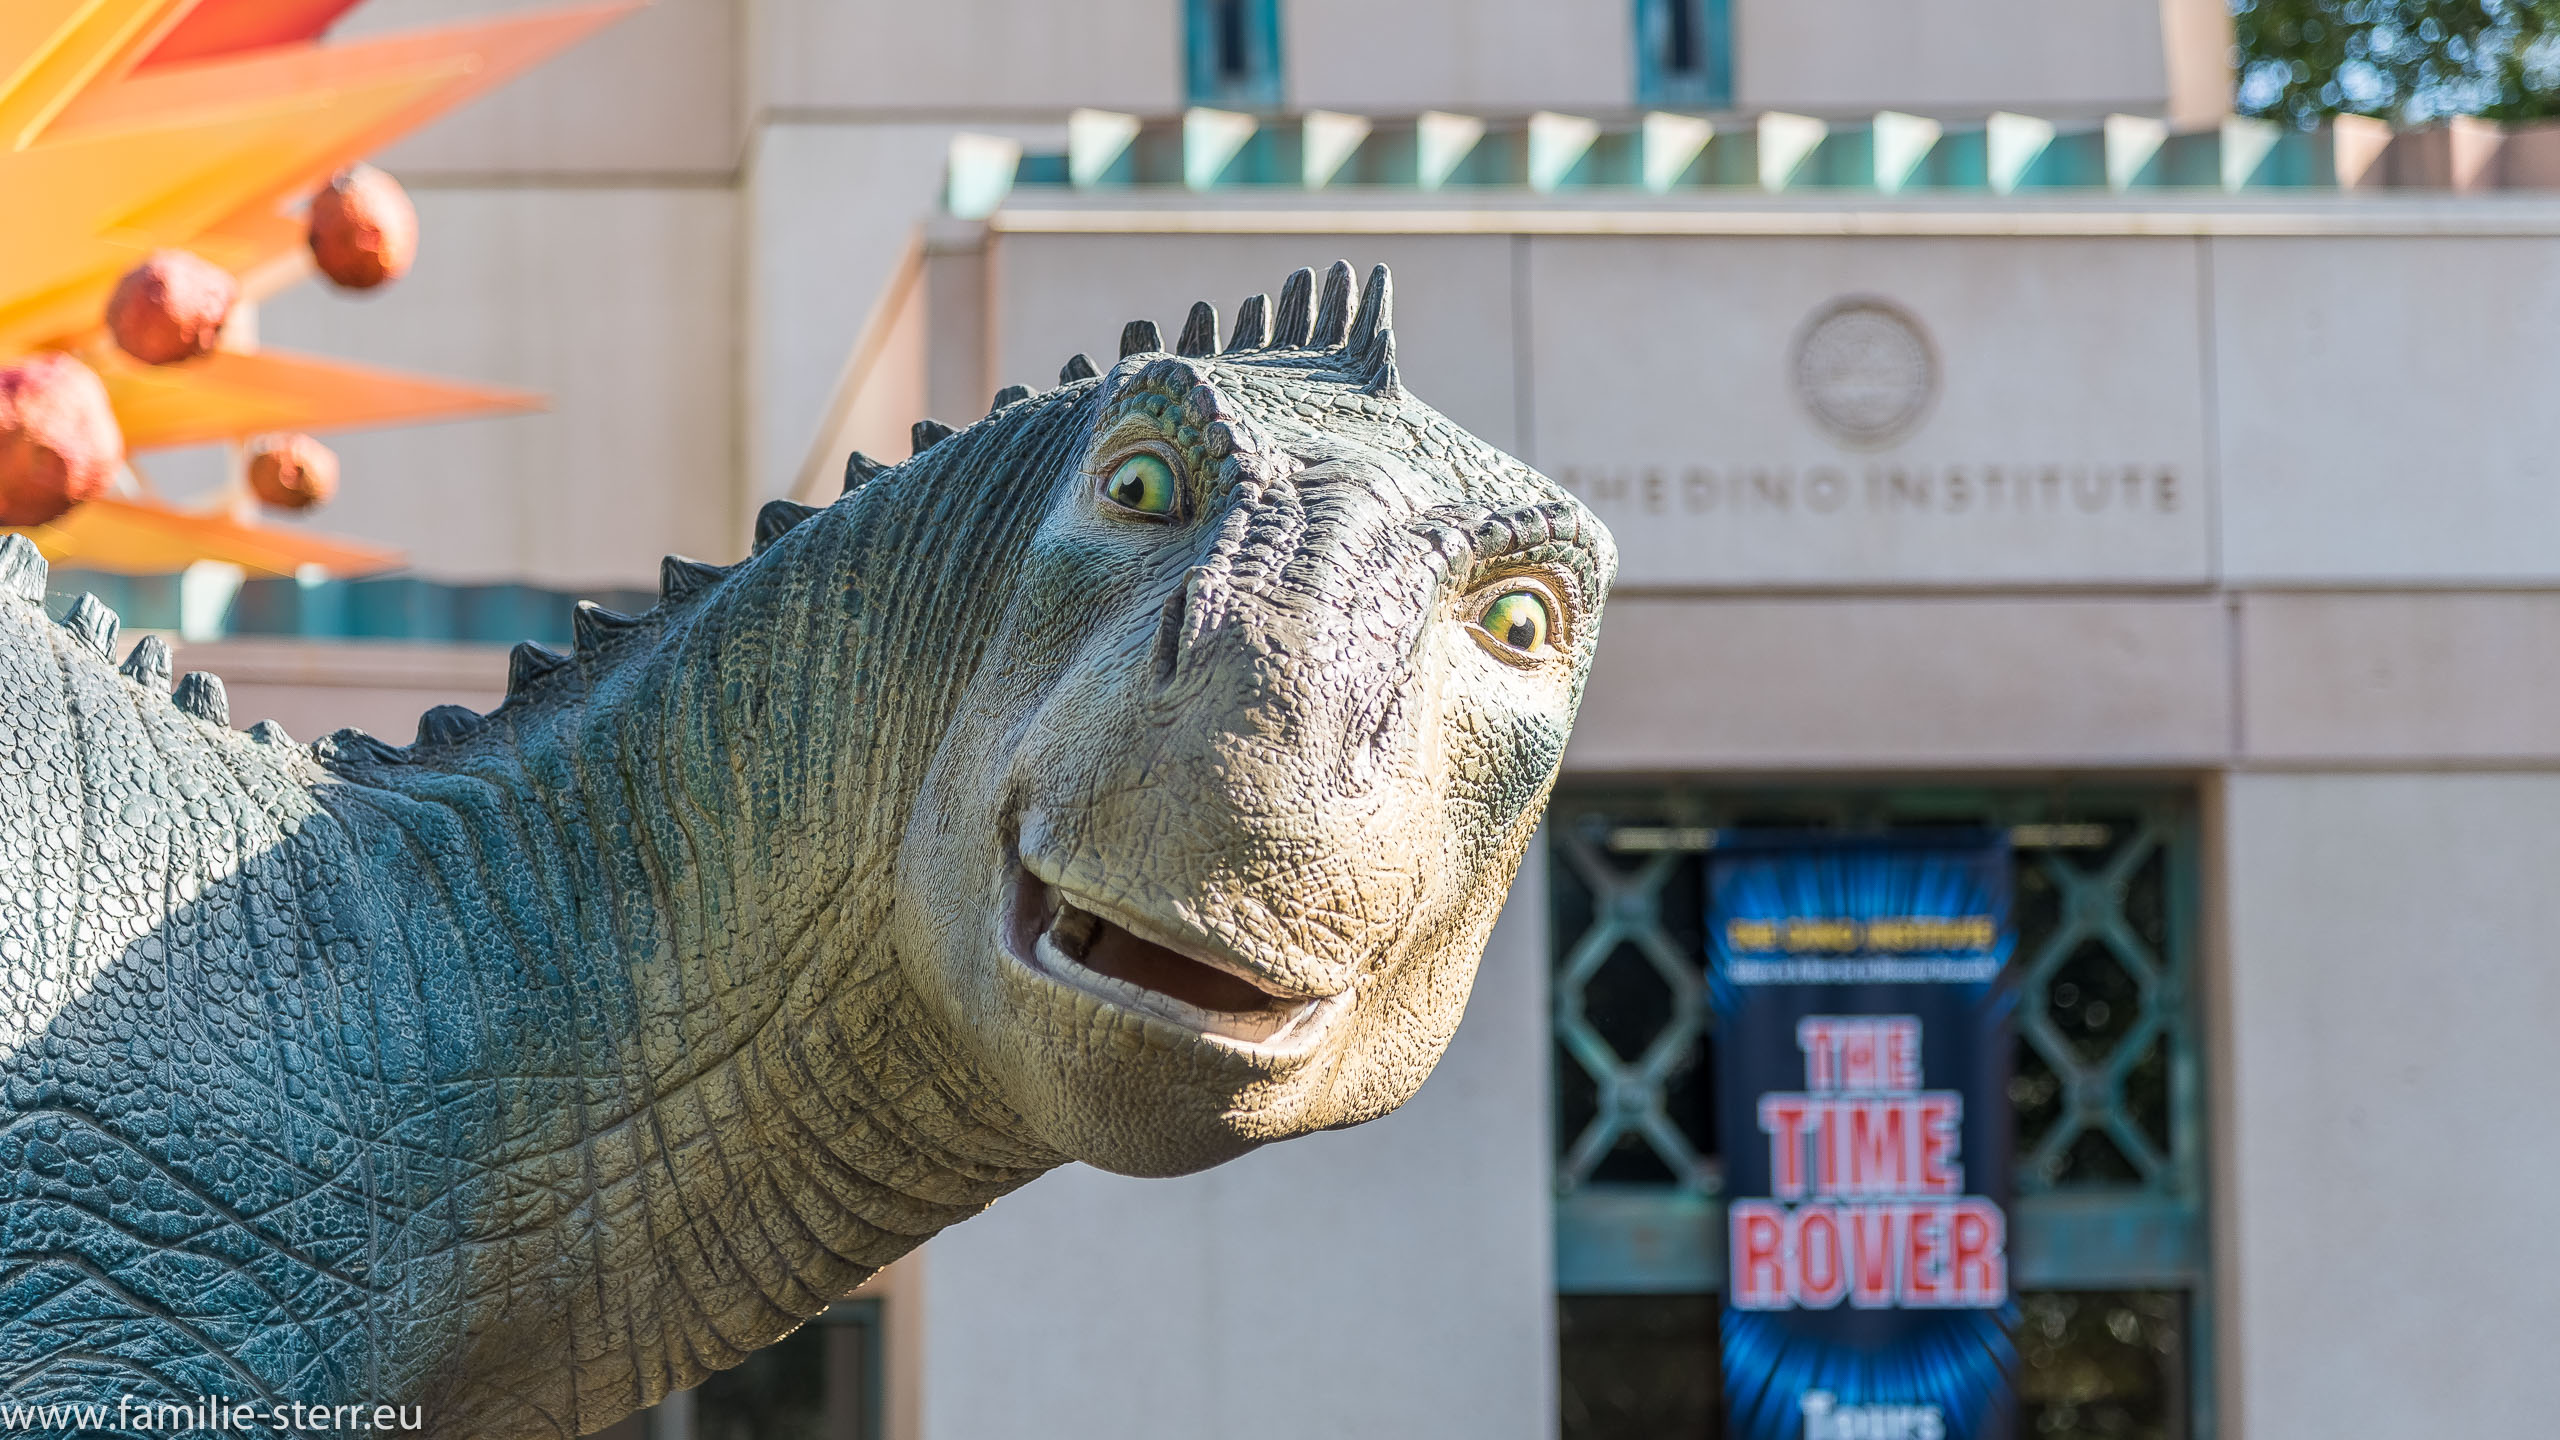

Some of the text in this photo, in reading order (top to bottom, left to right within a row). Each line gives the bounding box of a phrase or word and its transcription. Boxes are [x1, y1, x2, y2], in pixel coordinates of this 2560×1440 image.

[1558, 462, 2180, 515] THE DINO INSTITUTE
[1799, 1017, 1922, 1089] THE
[1758, 1092, 1964, 1197] TIME
[1730, 1200, 2008, 1309] ROVER
